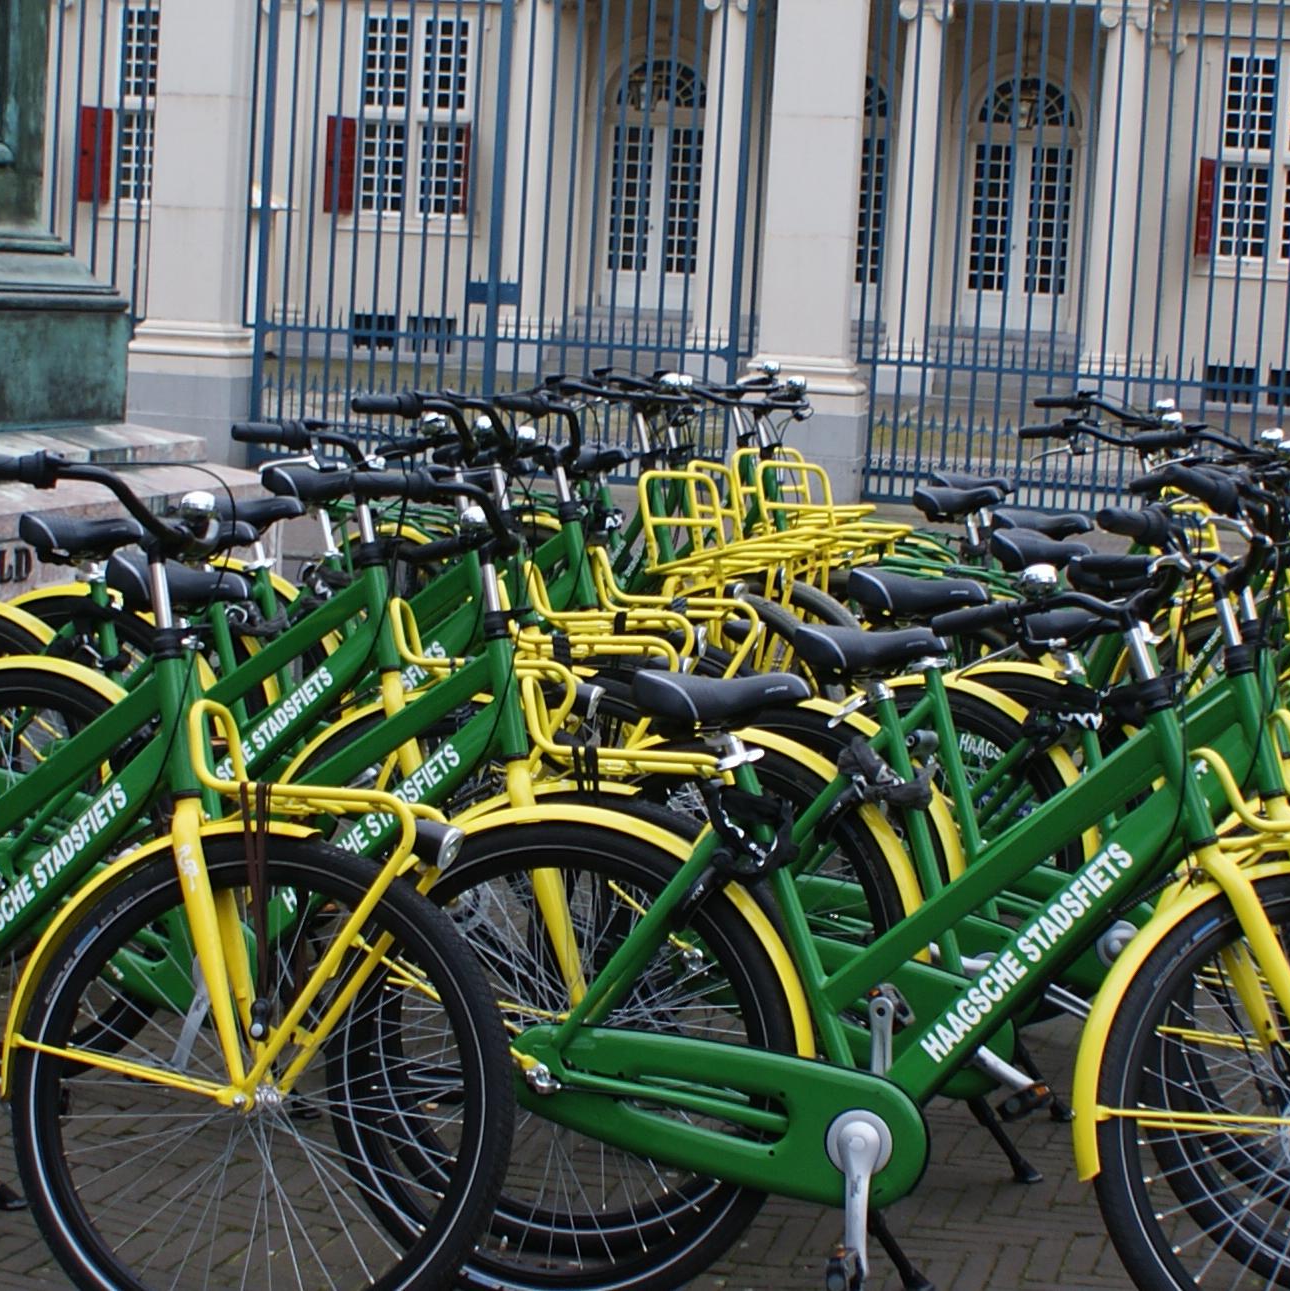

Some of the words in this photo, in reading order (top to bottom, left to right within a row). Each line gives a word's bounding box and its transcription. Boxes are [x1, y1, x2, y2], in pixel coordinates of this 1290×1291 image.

[251, 666, 334, 751] STADSFIETS
[959, 733, 1006, 761] HAAGS
[33, 782, 127, 889] STADSFIETS
[920, 950, 1029, 1064] HAAGSCHE
[1016, 842, 1133, 963] STADSFIETS
